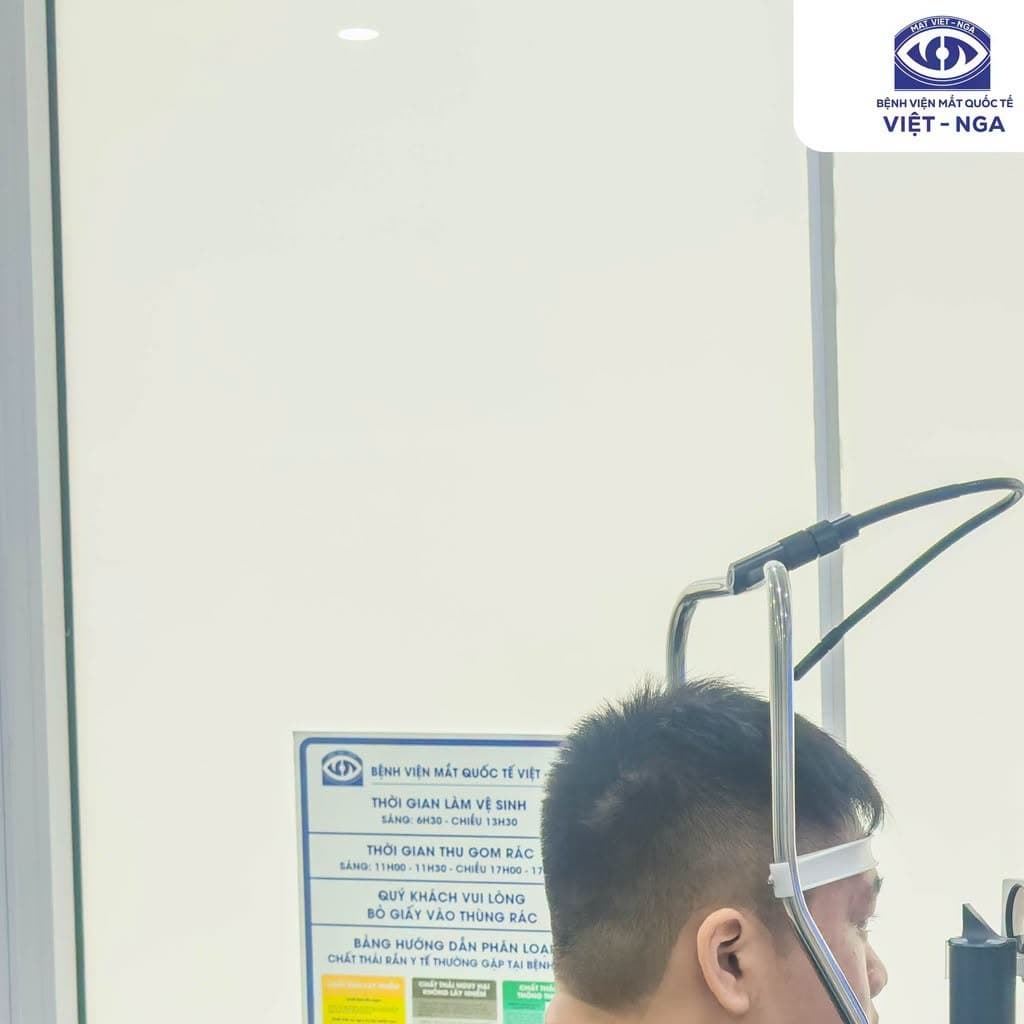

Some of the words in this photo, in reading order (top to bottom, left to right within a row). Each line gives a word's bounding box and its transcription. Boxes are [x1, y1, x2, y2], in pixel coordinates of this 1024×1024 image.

[371, 765, 400, 779] BỆNH
[405, 765, 430, 780] VIỆN
[434, 763, 458, 778] MẮT
[462, 764, 498, 779] QUỐC
[502, 764, 515, 778] TẾ
[518, 766, 541, 781] VIỆT
[372, 796, 402, 809] THỜI
[406, 798, 440, 810] GIAN
[444, 796, 472, 810] LÀM
[477, 796, 492, 814] VỆ
[496, 800, 526, 811] SINH
[416, 816, 442, 825] 6H30
[486, 817, 518, 826] 13H30
[367, 844, 397, 856] THỜI
[402, 846, 435, 857] GIAN
[440, 846, 464, 858] THU
[468, 848, 500, 859] GOM
[506, 846, 534, 860] RÁC
[374, 863, 406, 872] 11H00
[416, 864, 447, 873] 11H30
[490, 865, 522, 875] 17H00
[378, 887, 404, 902] QUÝ
[410, 888, 457, 904] KHÁCH
[462, 893, 484, 904] VUI
[488, 890, 526, 905] LÒNG
[390, 904, 421, 920] GIẤY
[426, 908, 455, 922] VÀO
[460, 908, 504, 923] THÙNG
[510, 910, 537, 924] RÁC
